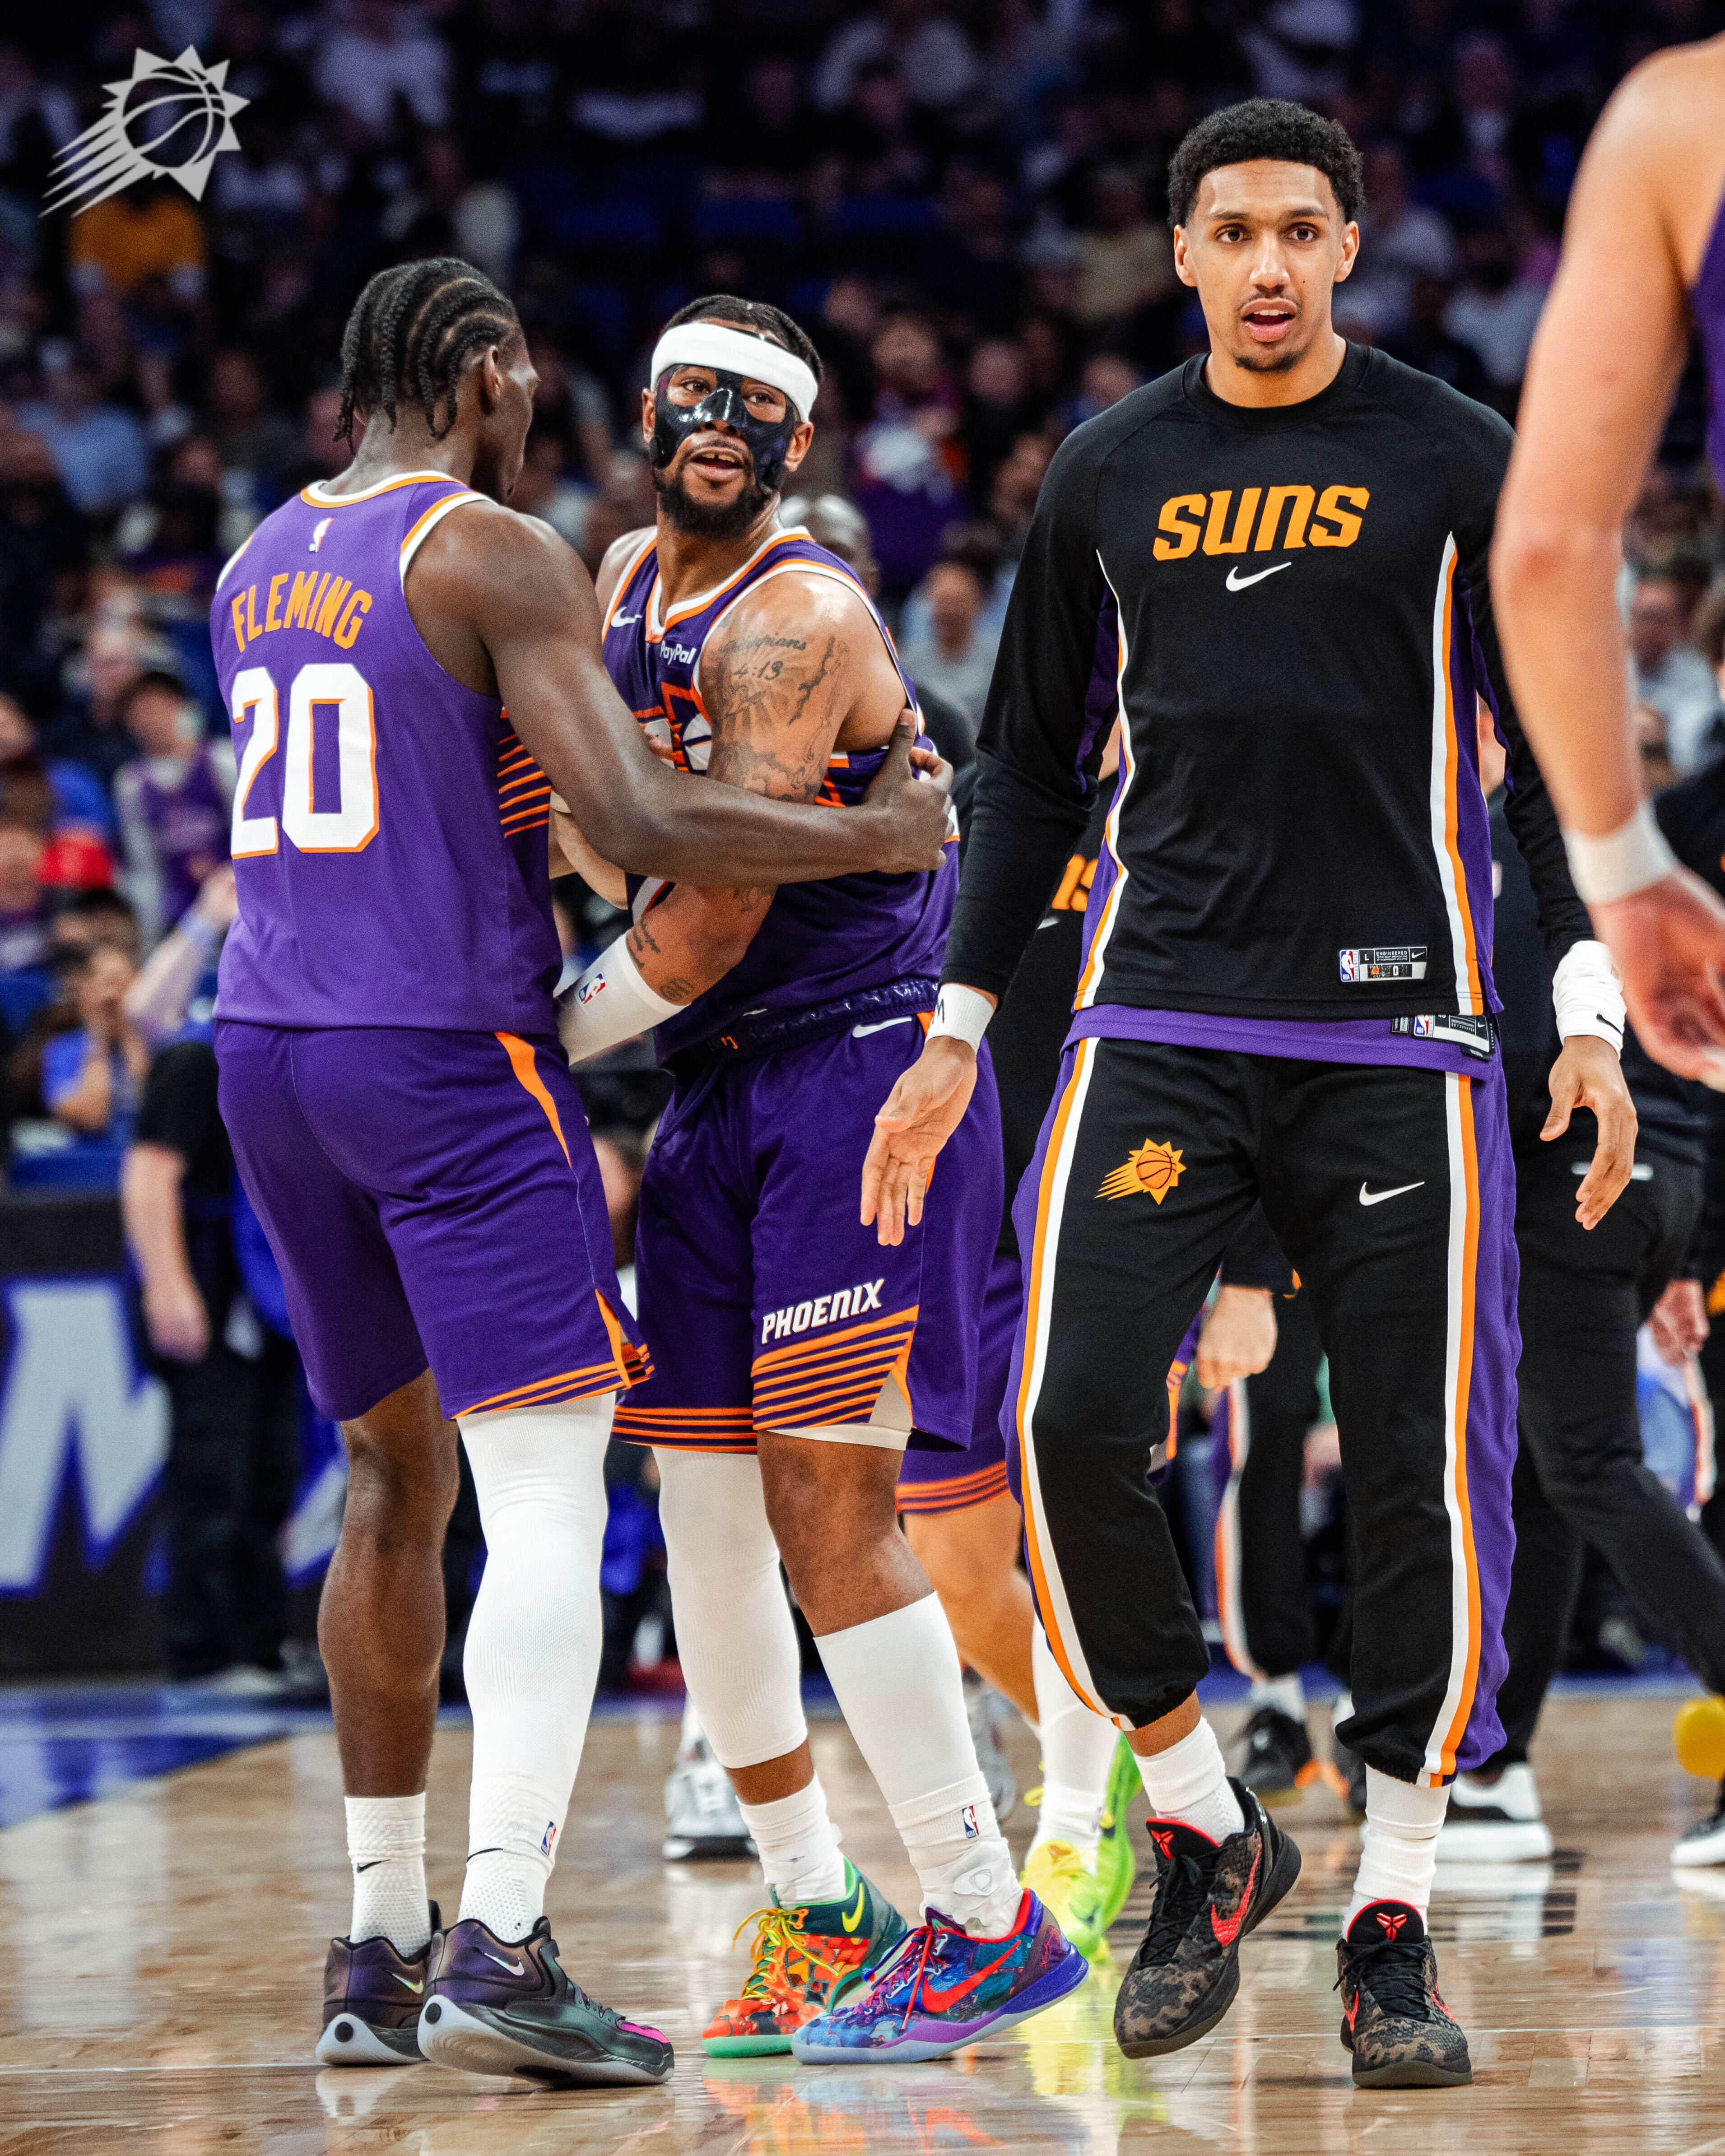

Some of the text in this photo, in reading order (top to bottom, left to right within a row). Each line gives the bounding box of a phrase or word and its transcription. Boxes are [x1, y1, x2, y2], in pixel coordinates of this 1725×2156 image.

[1153, 485, 1370, 561] SUNS
[232, 571, 372, 652] FLEMING
[660, 640, 697, 664] PayPal
[231, 663, 379, 859] 20
[761, 1278, 885, 1344] PHOENIX
